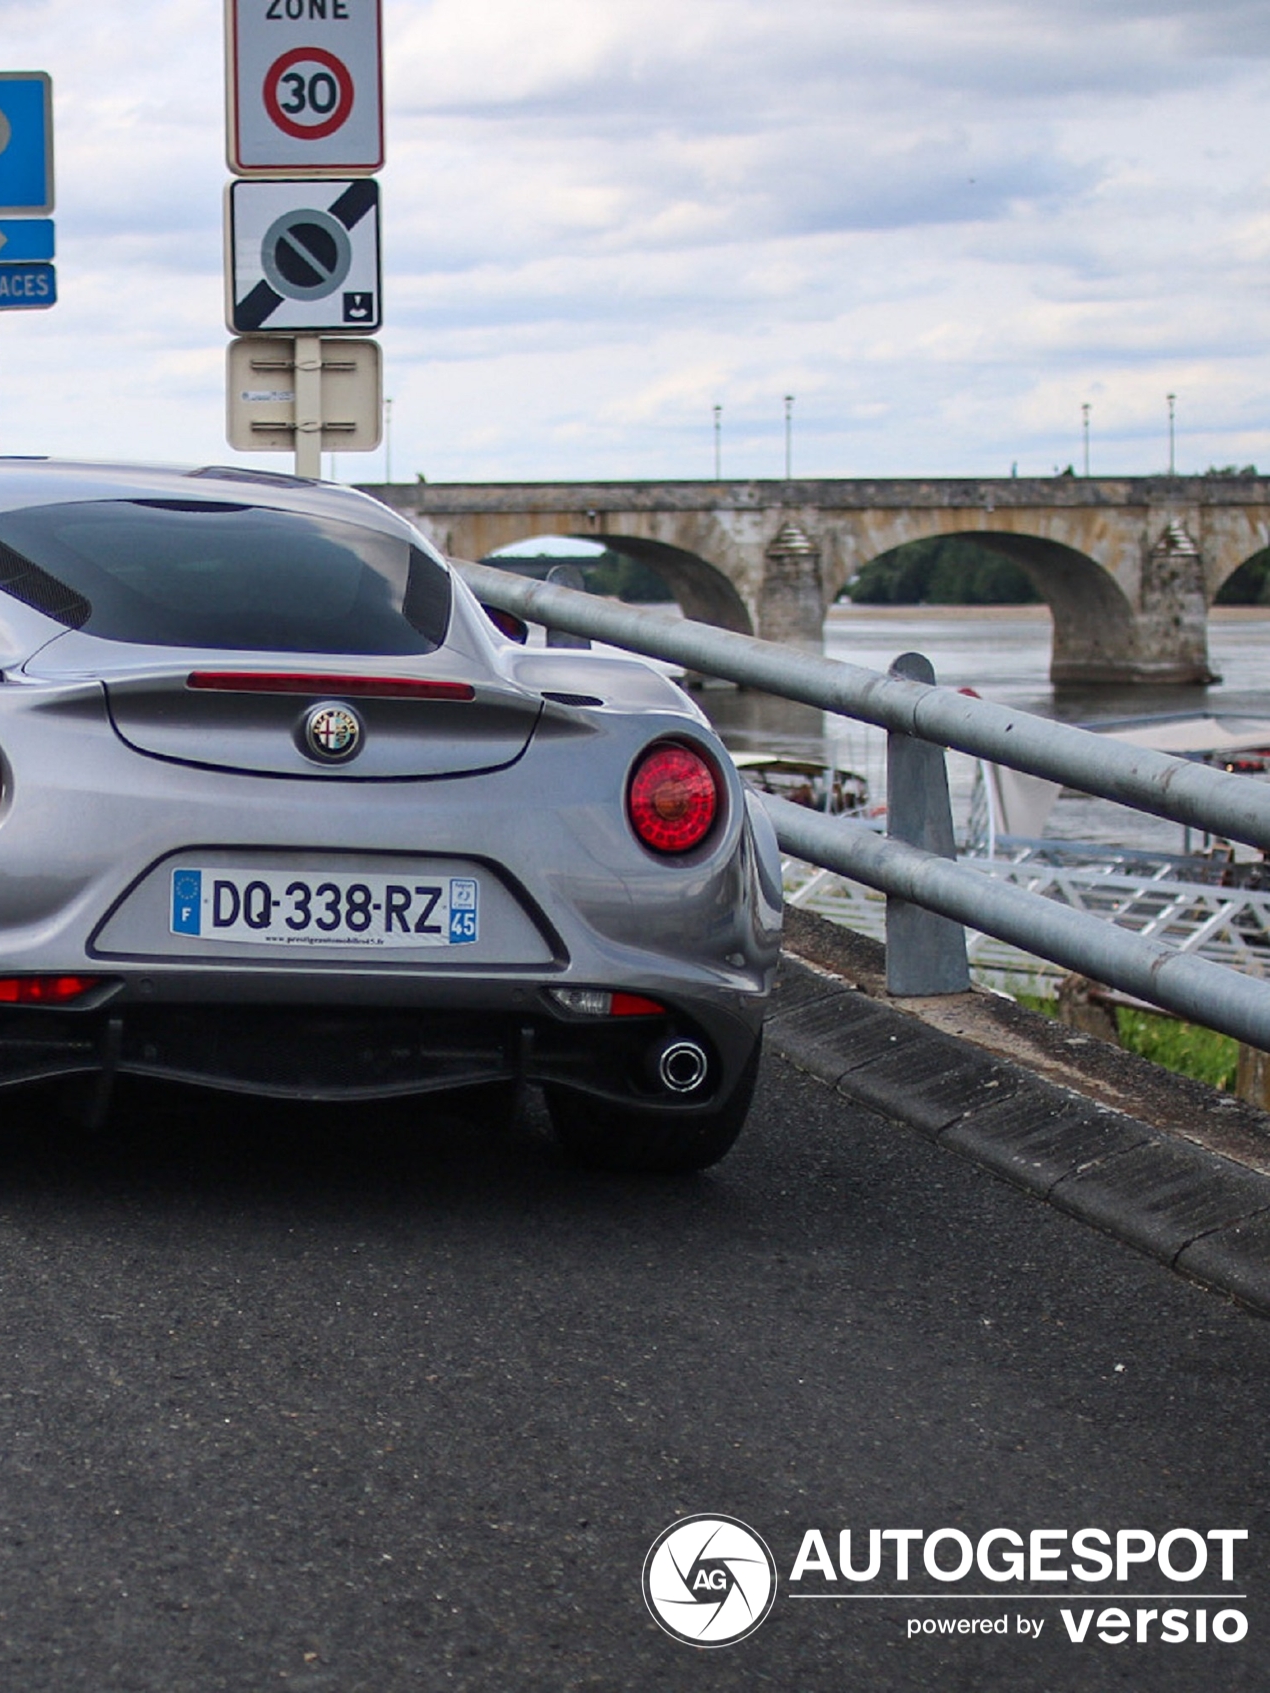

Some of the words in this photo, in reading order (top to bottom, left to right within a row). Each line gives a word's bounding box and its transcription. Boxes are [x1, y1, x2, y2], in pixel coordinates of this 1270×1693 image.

[266, 0, 350, 20] ZONE
[280, 72, 337, 114] 30
[181, 906, 192, 923] F
[213, 880, 443, 934] DQ-338-RZ
[451, 912, 476, 936] 45
